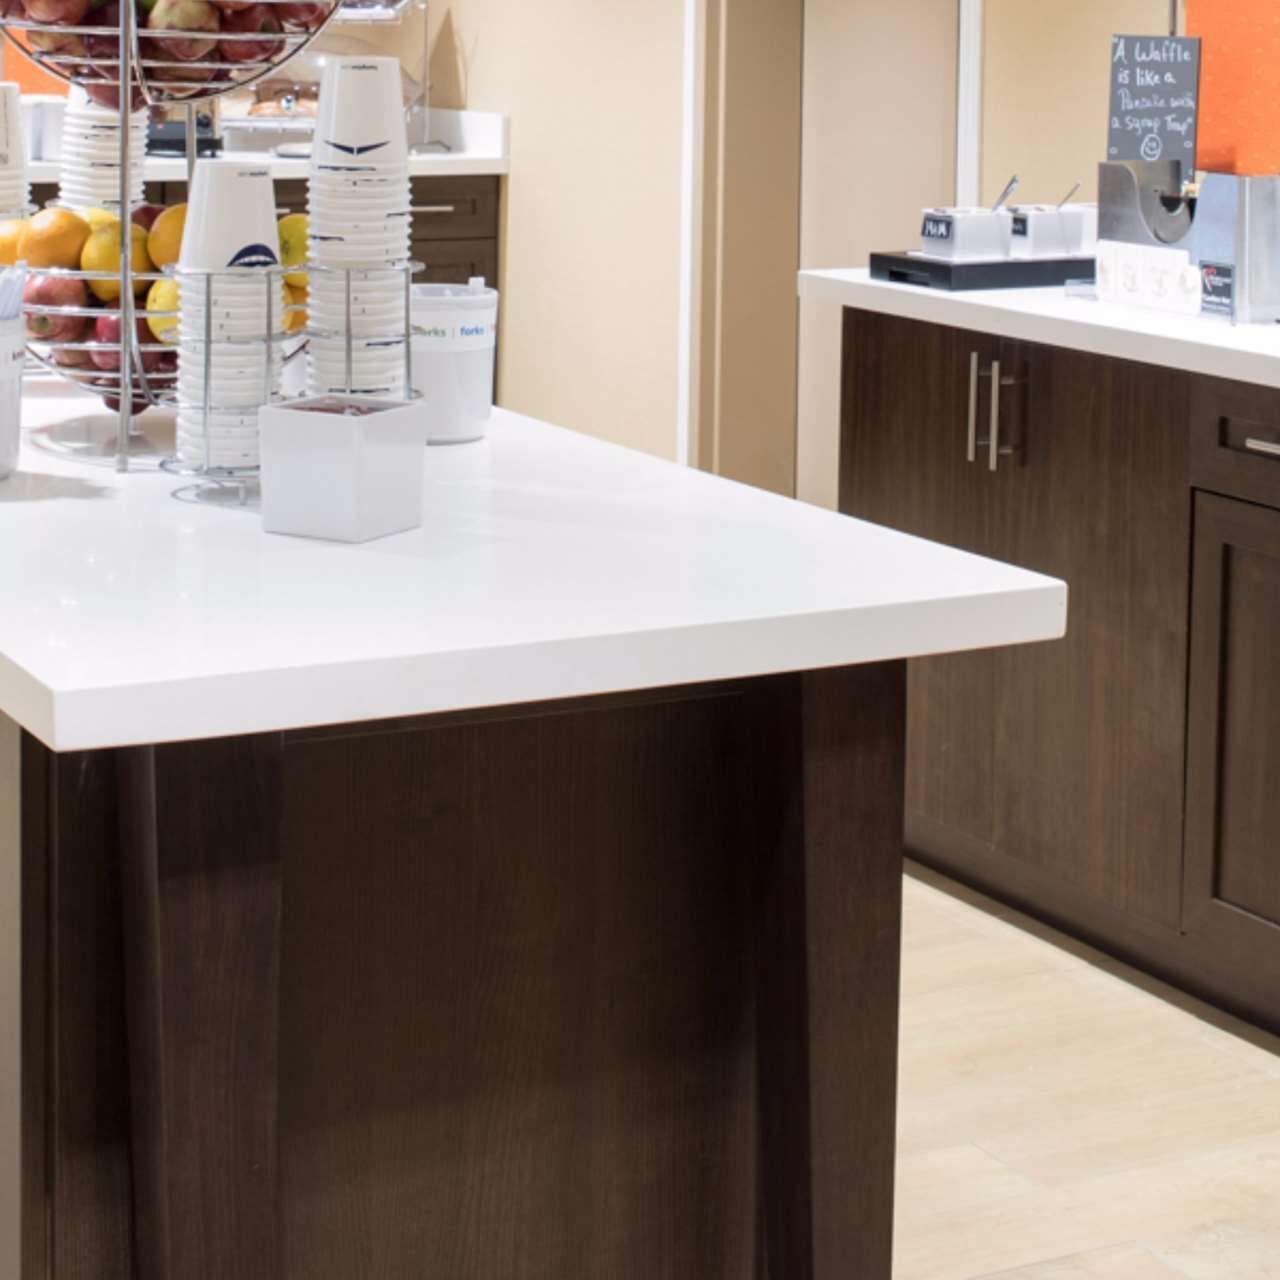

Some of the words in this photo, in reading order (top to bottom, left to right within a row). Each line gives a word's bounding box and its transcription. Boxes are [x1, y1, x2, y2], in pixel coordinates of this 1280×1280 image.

[1135, 40, 1192, 62] Waffle
[1136, 67, 1160, 86] like
[1164, 71, 1176, 84] a
